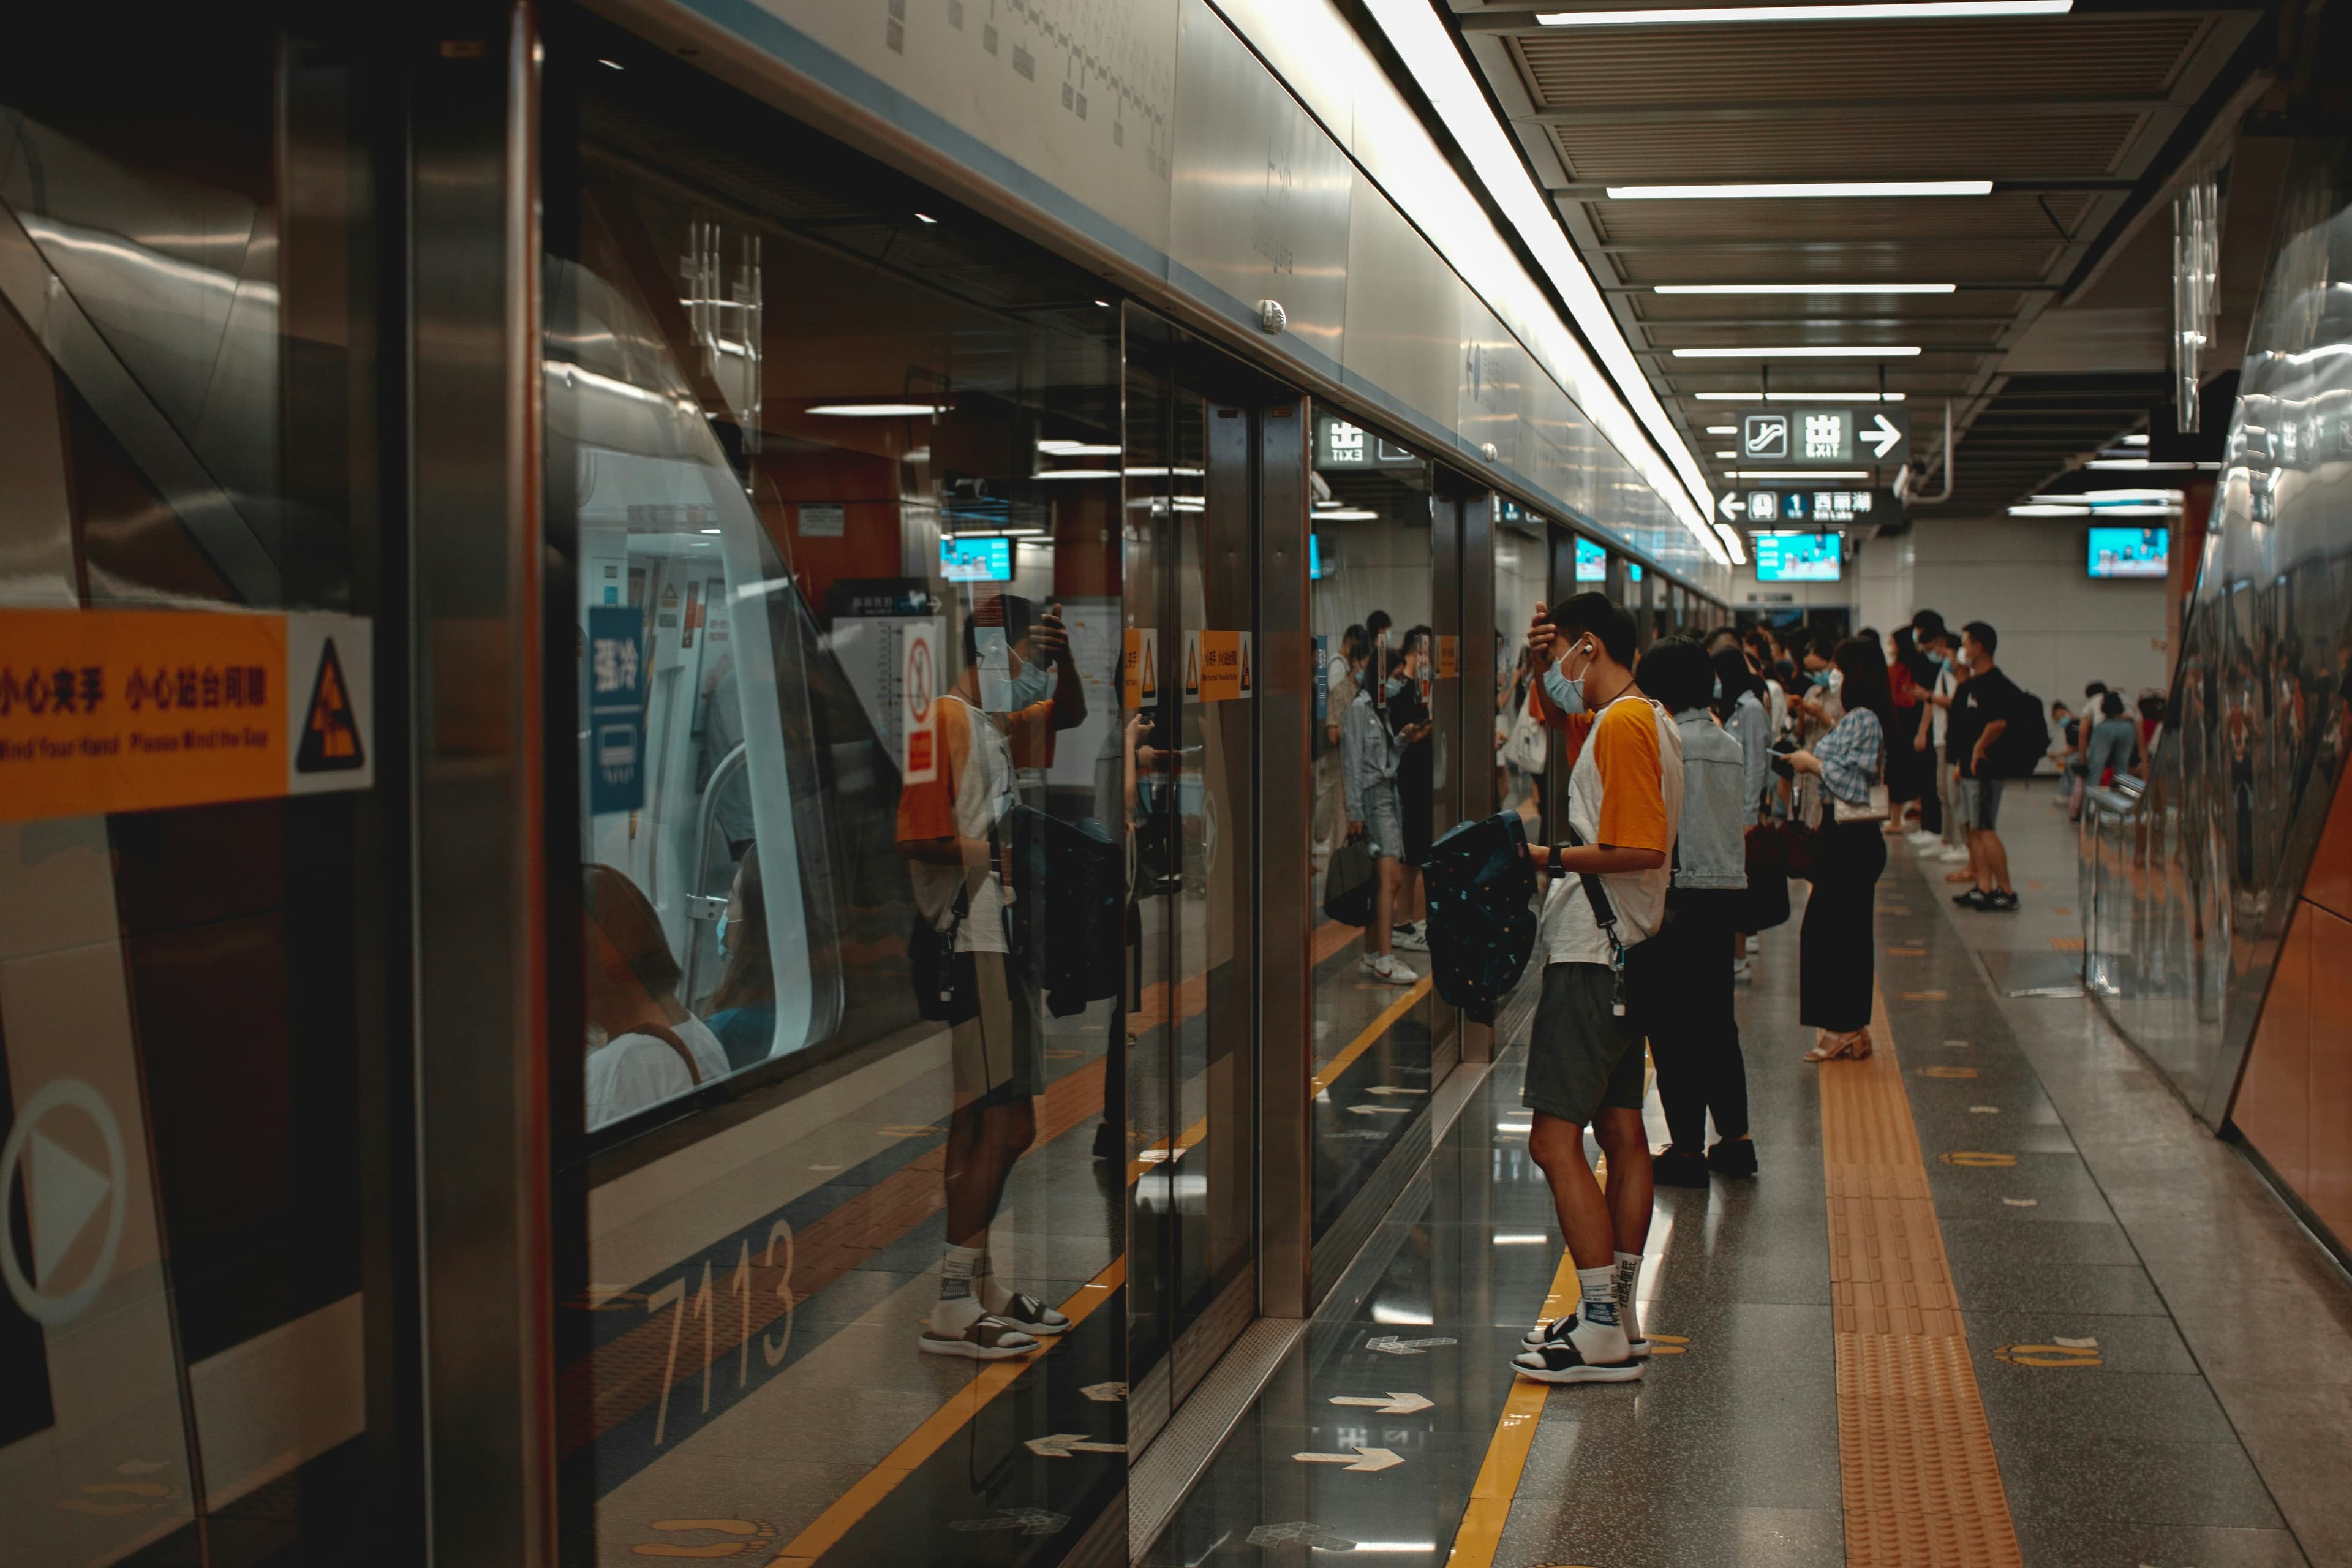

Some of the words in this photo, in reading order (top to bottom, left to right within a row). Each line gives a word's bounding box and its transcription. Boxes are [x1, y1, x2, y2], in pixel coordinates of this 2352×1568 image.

[1805, 415, 1840, 443] 出
[1806, 443, 1839, 458] EXIT
[1814, 492, 1872, 512] 西丽湖
[647, 1218, 794, 1447] 7113
